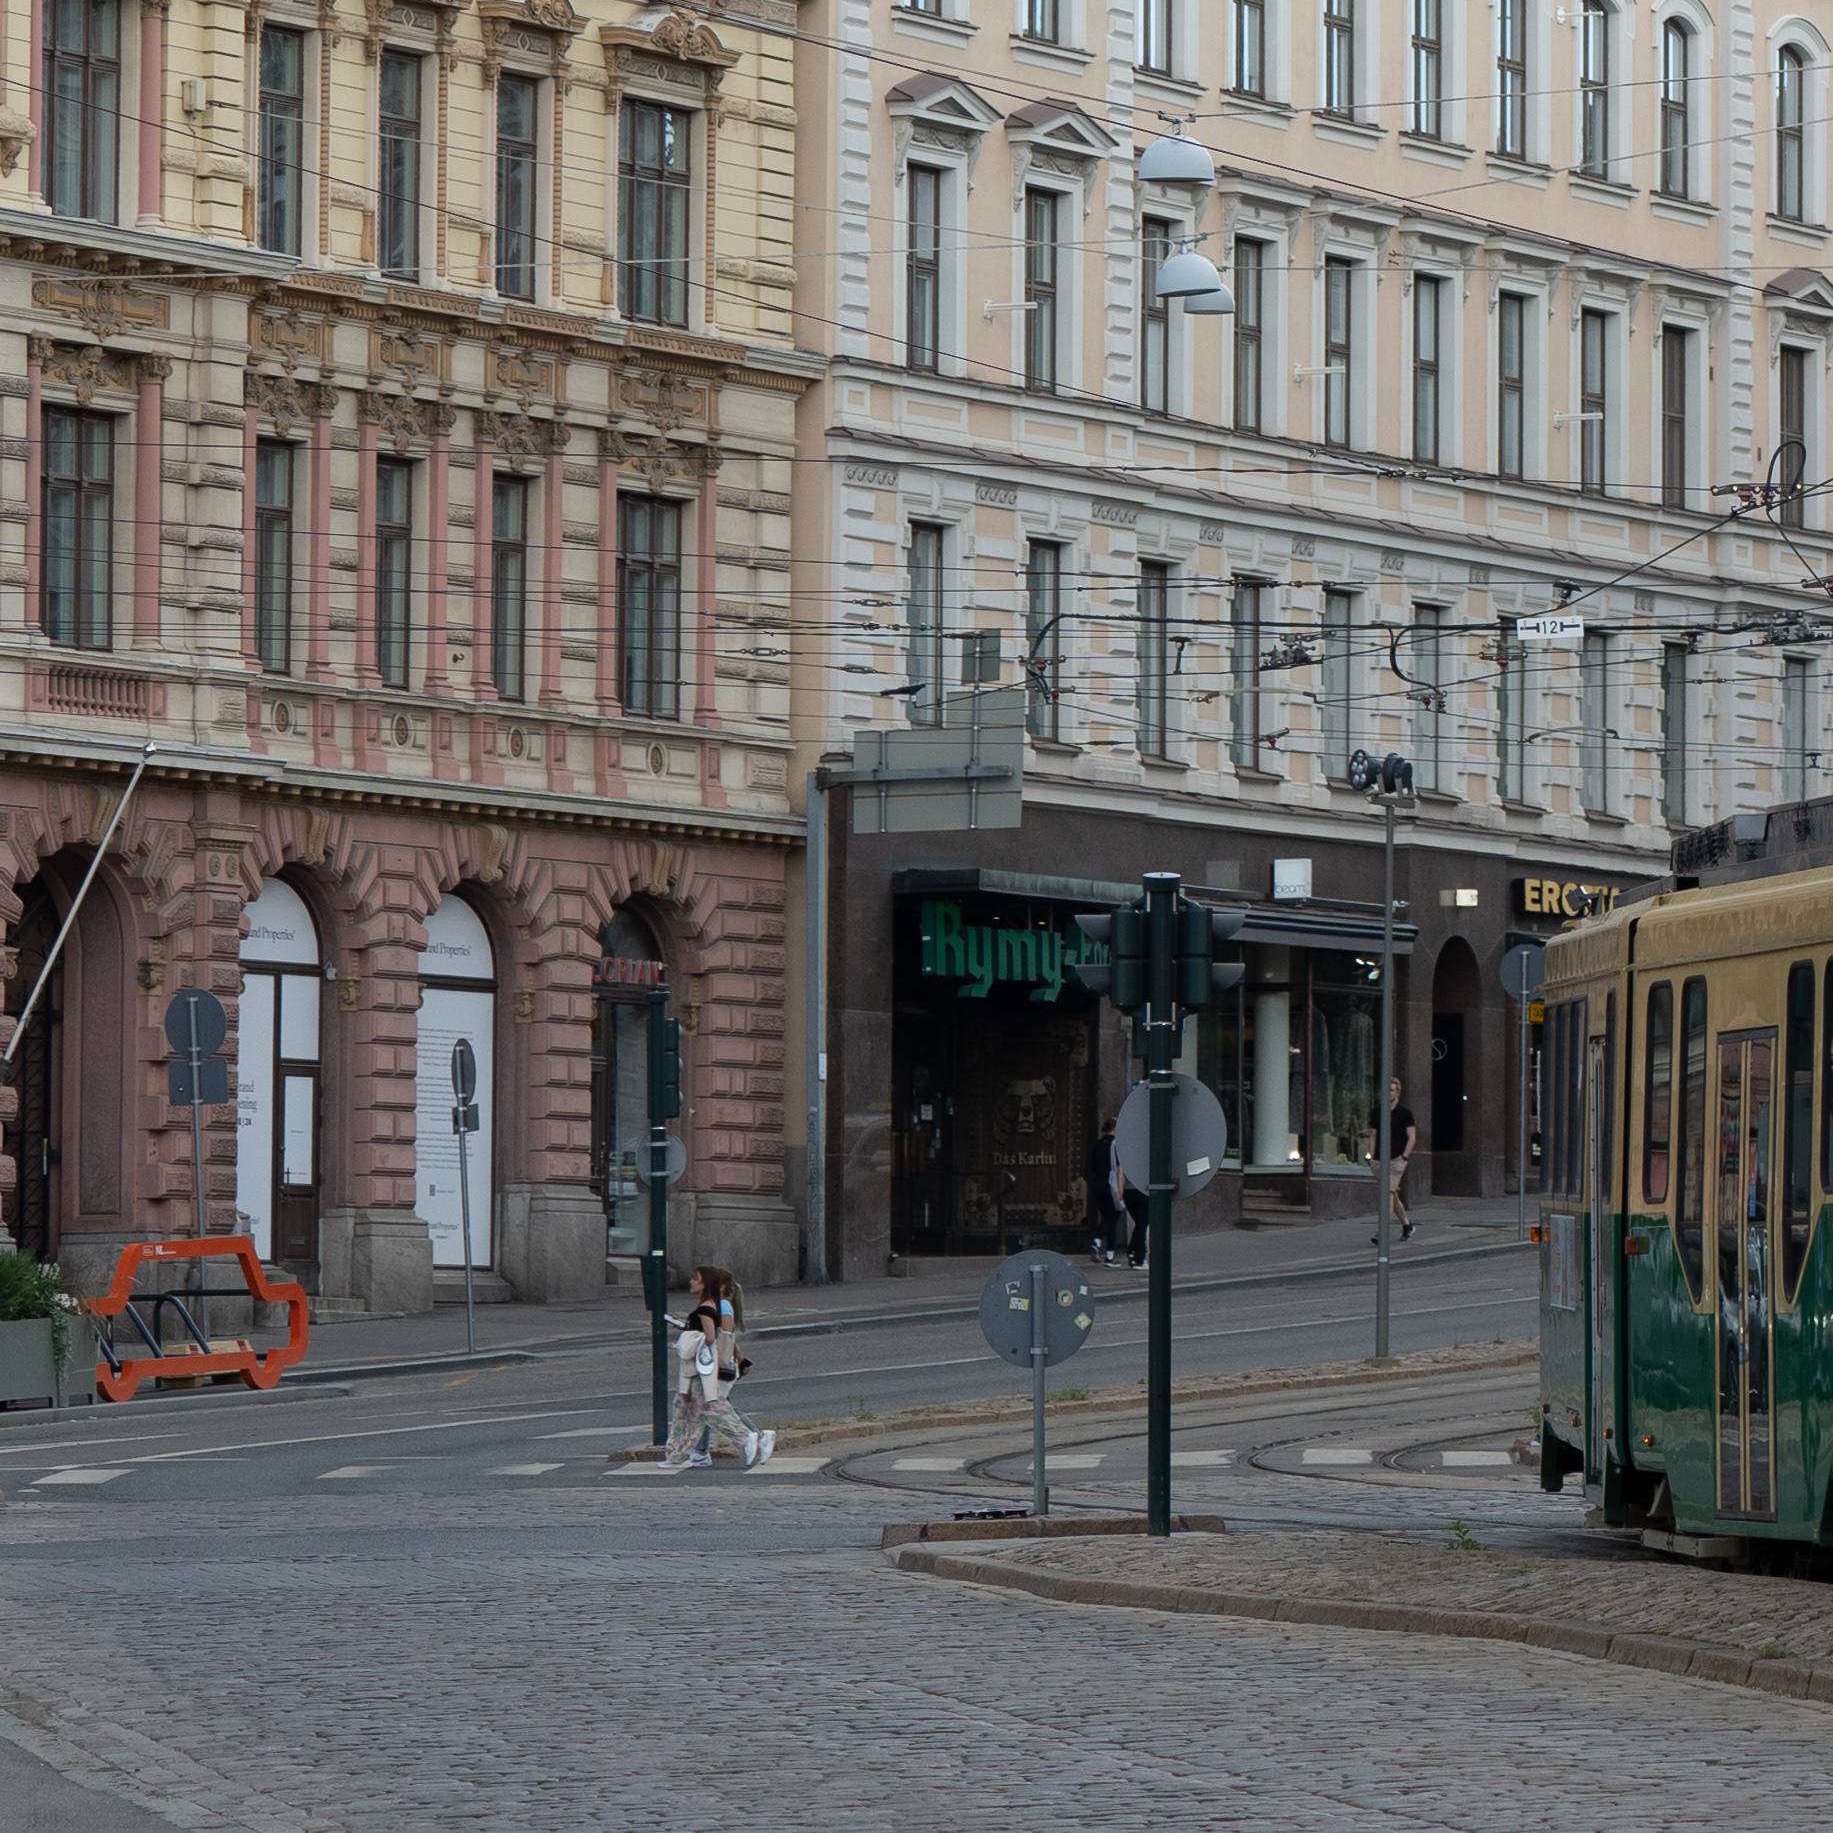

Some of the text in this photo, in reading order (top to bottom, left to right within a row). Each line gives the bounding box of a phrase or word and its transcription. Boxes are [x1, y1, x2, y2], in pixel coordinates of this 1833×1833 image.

[1542, 620, 1558, 634] 12
[993, 1151, 1058, 1165] Das Karhu
